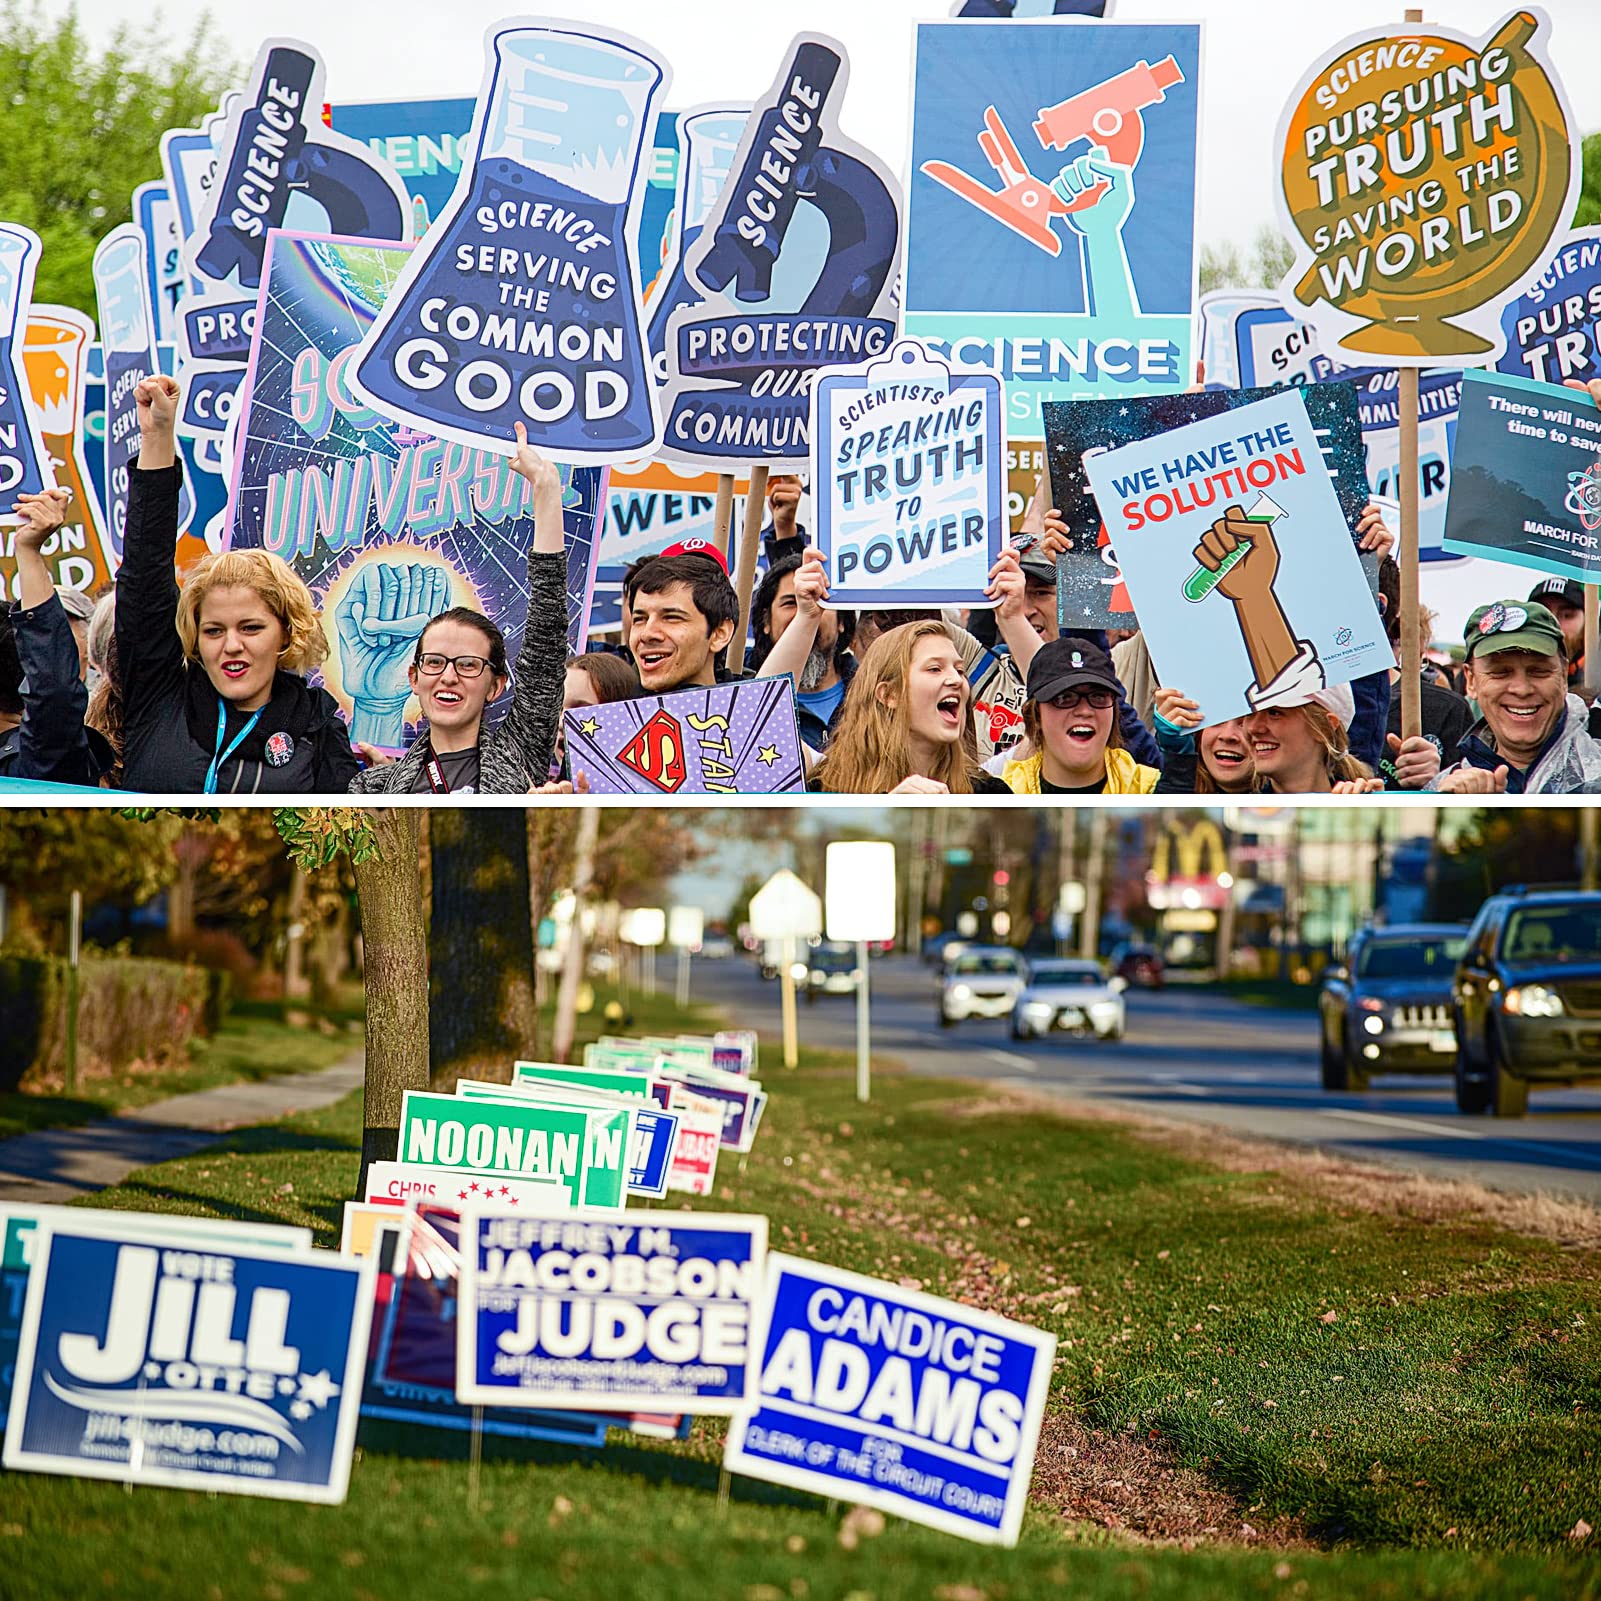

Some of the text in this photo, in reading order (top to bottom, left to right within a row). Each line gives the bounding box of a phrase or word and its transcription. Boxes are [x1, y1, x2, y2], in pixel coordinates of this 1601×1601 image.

[1305, 48, 1510, 159] PURSUING
[1315, 42, 1445, 111] SCIENCE
[231, 78, 300, 238] SCIENCE
[737, 75, 820, 248] SCIENCE
[1308, 83, 1515, 209] TRUTH
[476, 200, 612, 254] SCIENCE
[1313, 147, 1520, 254] SAVING THE
[455, 244, 617, 300] SERVING
[1318, 189, 1523, 301] WORLD
[498, 281, 550, 313] THE
[419, 297, 624, 363] COMMON
[688, 320, 887, 360] PROTECTING
[1522, 319, 1601, 384] TR
[393, 337, 630, 423] GOOD
[751, 369, 815, 399] OUR
[838, 384, 945, 431] SCIENTISTS
[1488, 395, 1540, 418] There
[1542, 406, 1572, 426] will
[837, 400, 983, 464] SPEAKING
[1111, 467, 1160, 500] WE
[1162, 440, 1238, 484] HAVE
[1236, 422, 1294, 457] THE
[1507, 419, 1547, 439] time
[1550, 428, 1568, 444] to
[837, 434, 983, 503] TRUTH
[1122, 447, 1307, 531] SOLUTION
[896, 496, 921, 521] TO
[1523, 520, 1599, 549] MARCH FOR
[837, 515, 984, 583] POWER
[1322, 641, 1376, 662] MARCH FOR SCIENCE
[407, 1116, 579, 1177] NOONAN
[388, 1180, 436, 1198] CHRIS
[162, 1250, 236, 1280] VOTE
[480, 1218, 634, 1254] JEFFREY
[478, 1247, 753, 1300] JACOBSON
[496, 1295, 749, 1365] JUDGE
[806, 1287, 1006, 1384] CANDICE
[761, 1327, 1024, 1464] ADAMS
[746, 1425, 1006, 1521] CLERK OF THE CIRCUIT COURT
[861, 1436, 904, 1462] FOR
